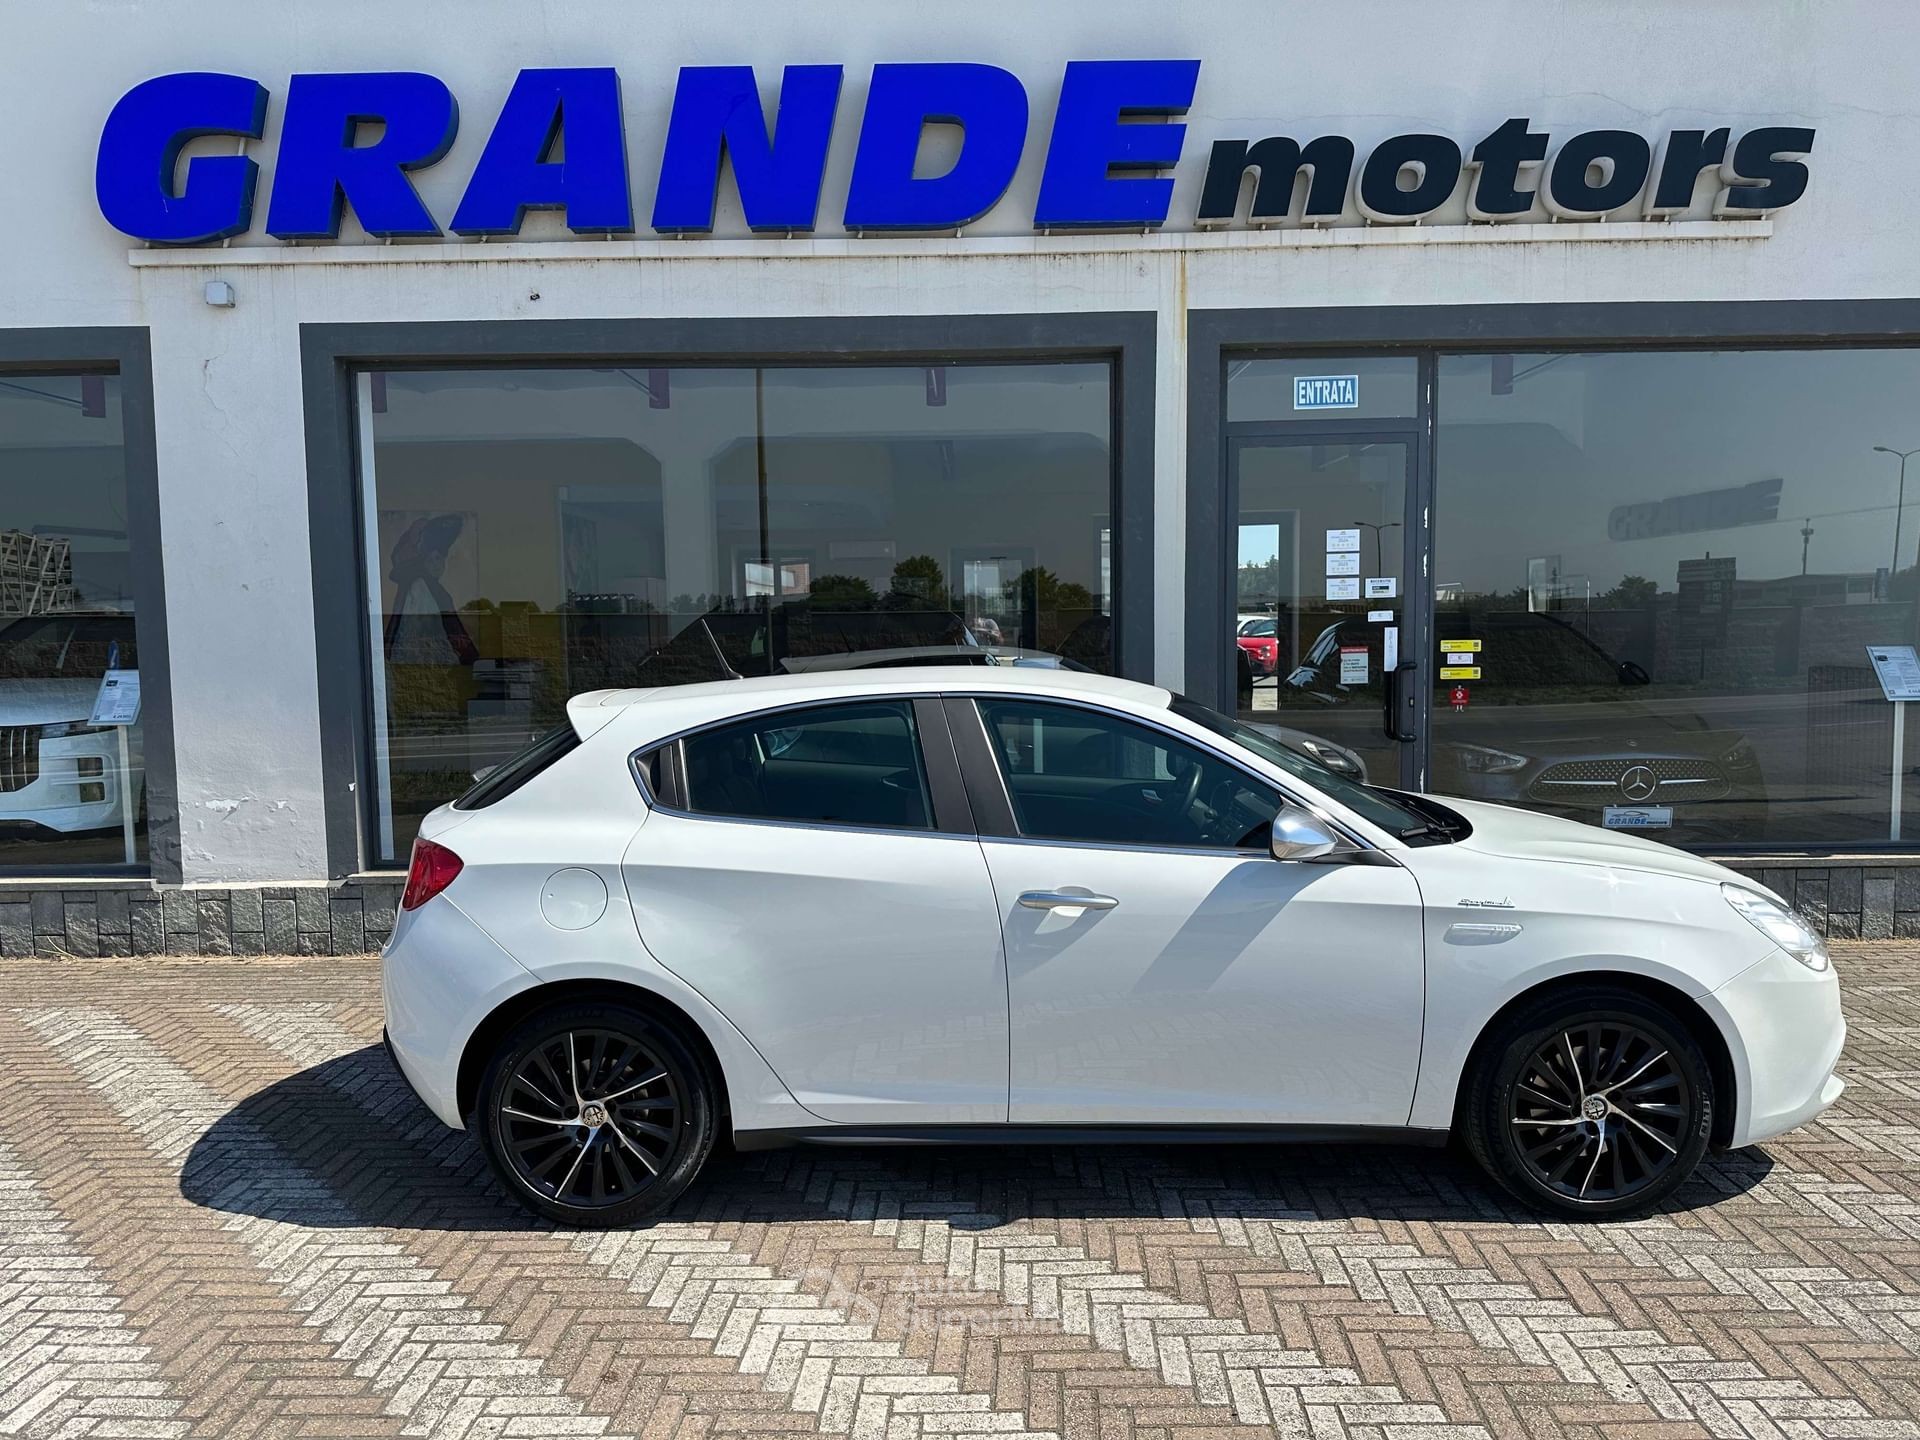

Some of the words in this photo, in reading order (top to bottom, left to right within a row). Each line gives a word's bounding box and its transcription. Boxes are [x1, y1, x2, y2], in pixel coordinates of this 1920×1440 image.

[95, 60, 1201, 247] GRANDE
[1195, 118, 1816, 224] motors
[1298, 380, 1354, 404] ENTRATA
[1608, 817, 1647, 825] GRANDE
